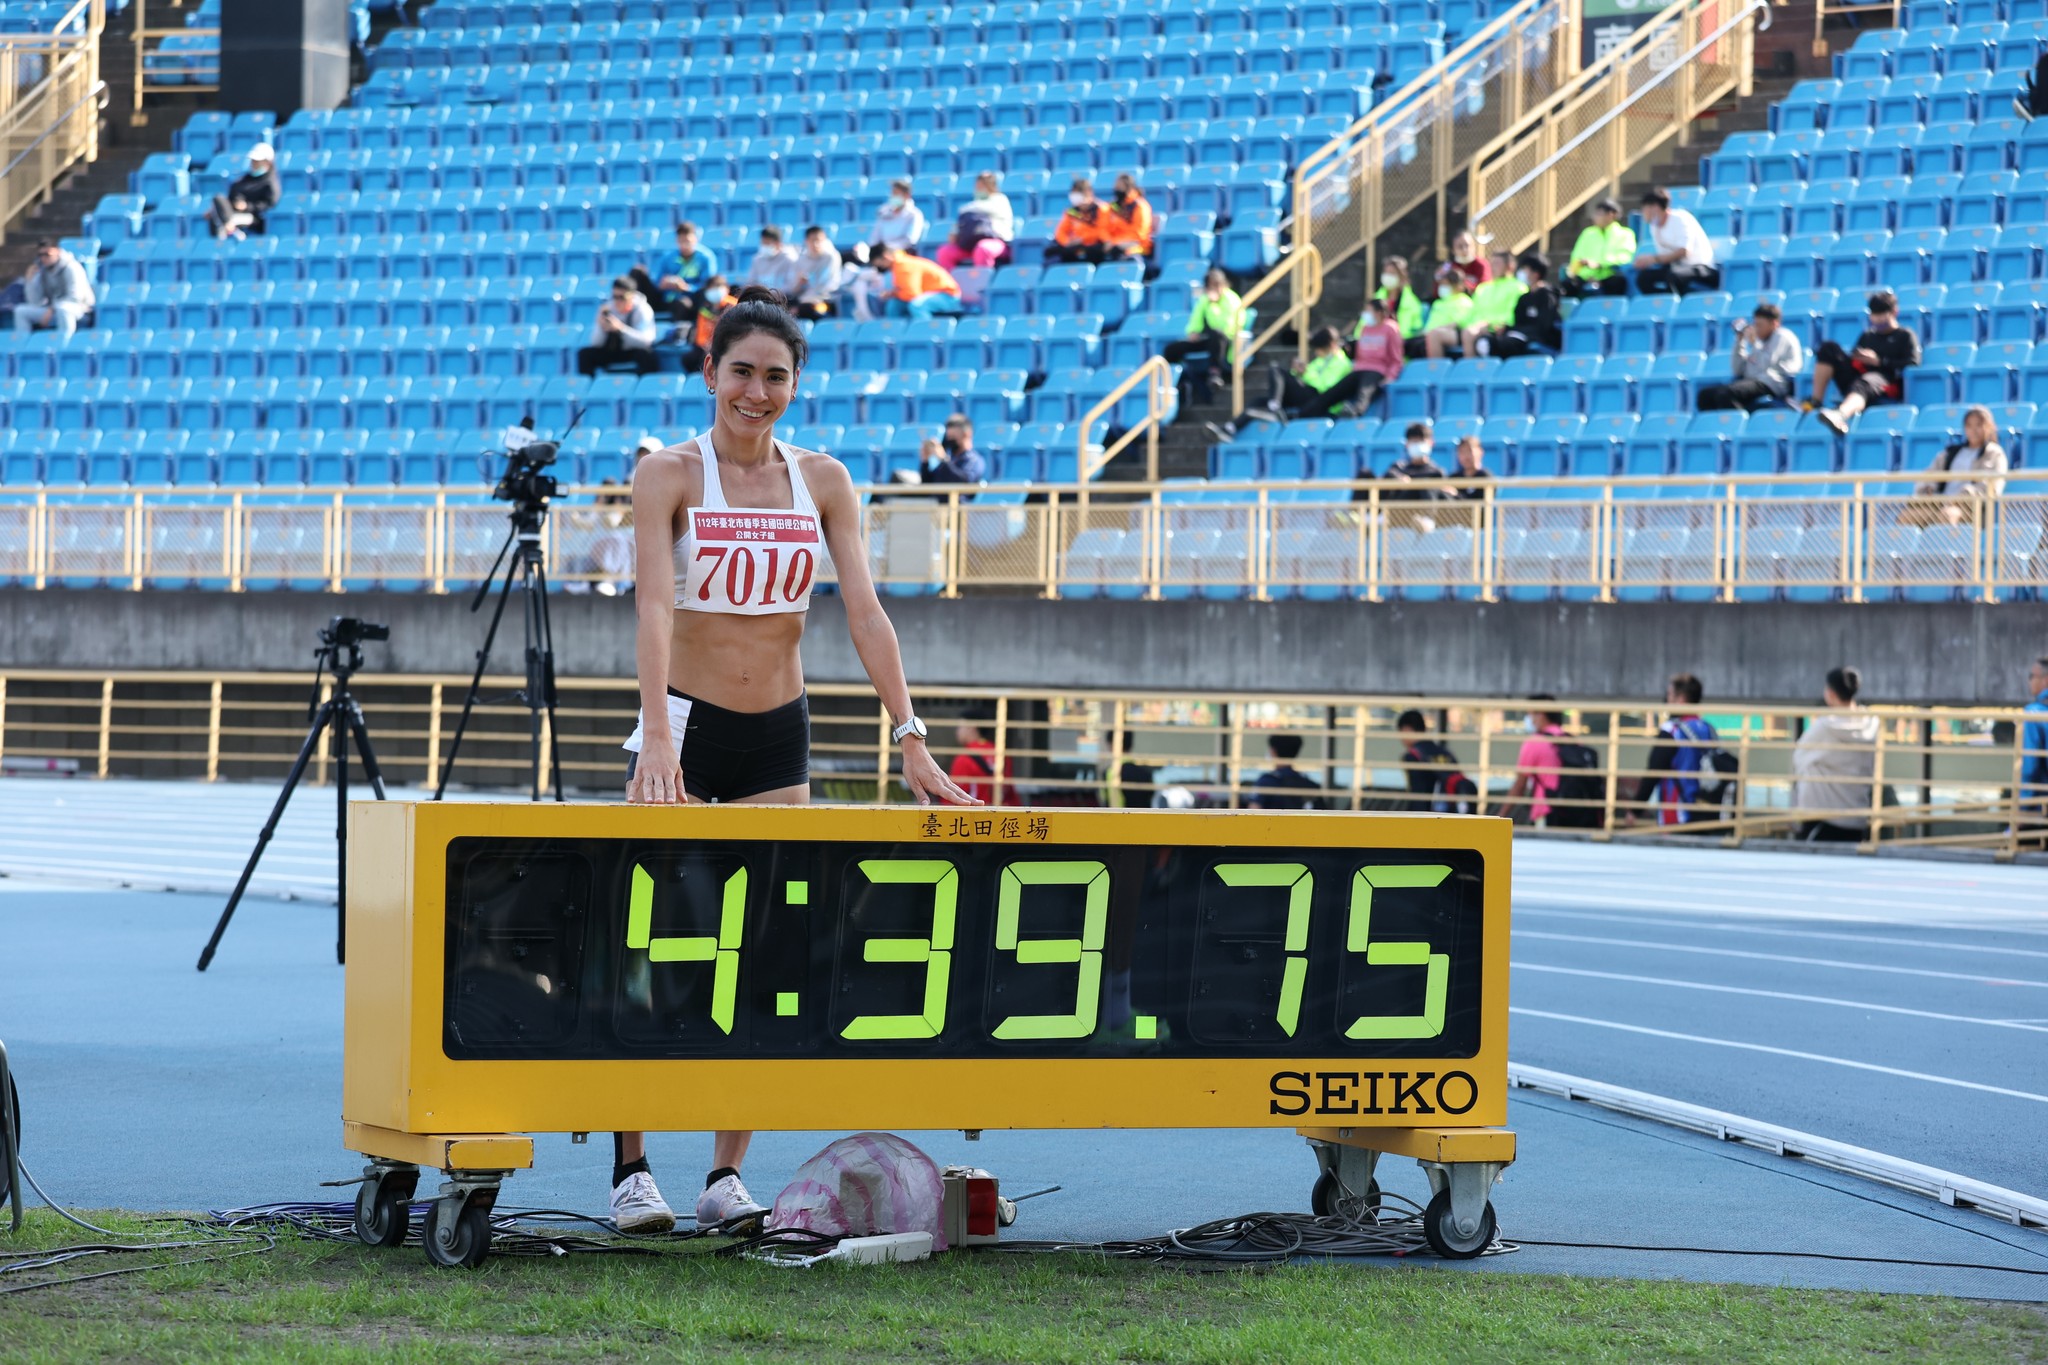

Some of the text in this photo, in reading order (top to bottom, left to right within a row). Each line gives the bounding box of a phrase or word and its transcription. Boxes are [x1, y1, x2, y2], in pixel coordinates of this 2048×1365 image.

[735, 530, 776, 540] 公開女子組
[695, 547, 814, 606] 7010
[921, 812, 1050, 841] 臺北田徑場
[627, 860, 1453, 1039] 4:39.75
[1269, 1070, 1479, 1116] SEIKO
